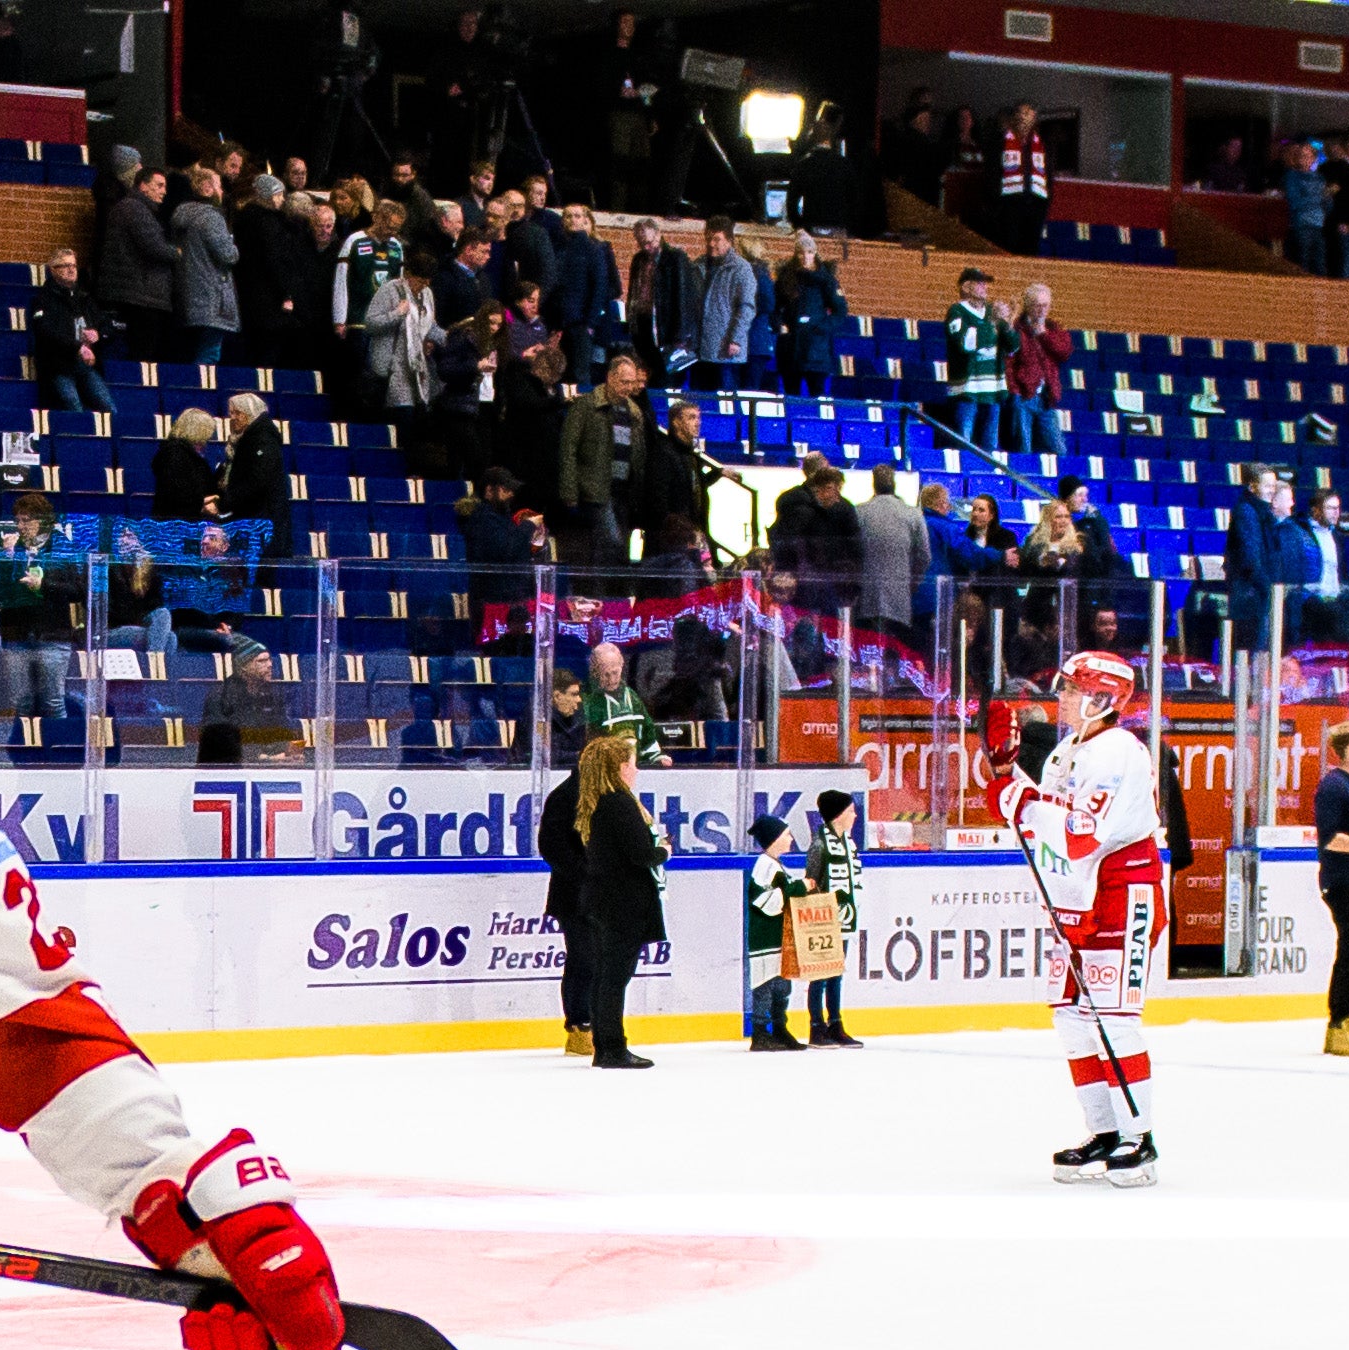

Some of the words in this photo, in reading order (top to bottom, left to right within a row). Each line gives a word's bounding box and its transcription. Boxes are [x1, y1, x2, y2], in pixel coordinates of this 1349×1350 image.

[307, 912, 471, 970] Salos
[1257, 917, 1295, 944] OUR
[1256, 947, 1307, 977] RAND
